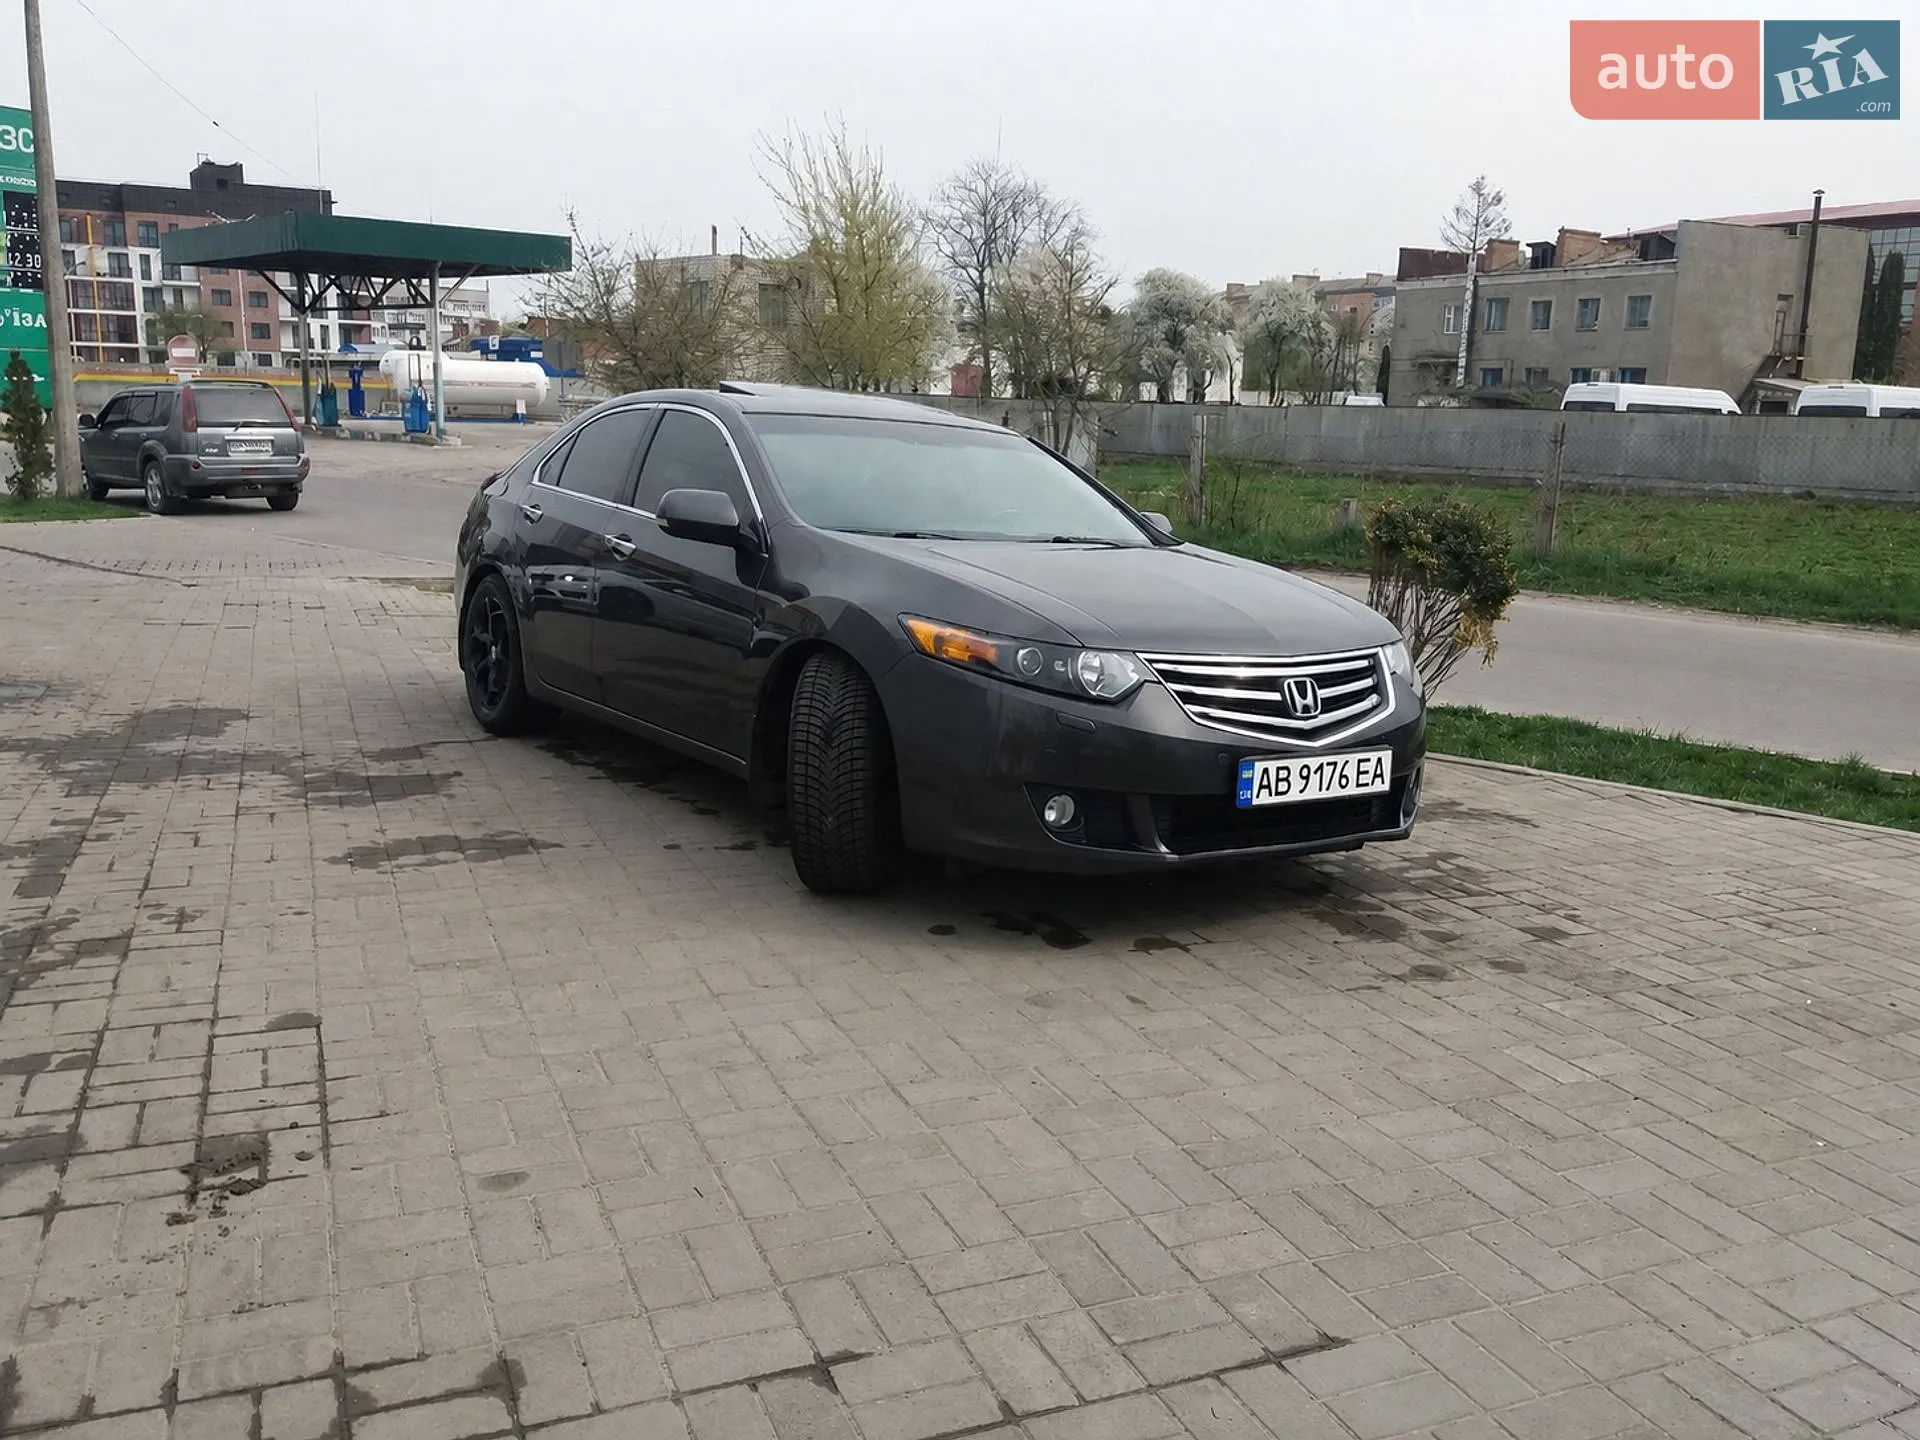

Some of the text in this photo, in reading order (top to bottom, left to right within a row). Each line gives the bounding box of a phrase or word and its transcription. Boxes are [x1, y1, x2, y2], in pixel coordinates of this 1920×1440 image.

[1256, 756, 1385, 799] AB 9176 EA
